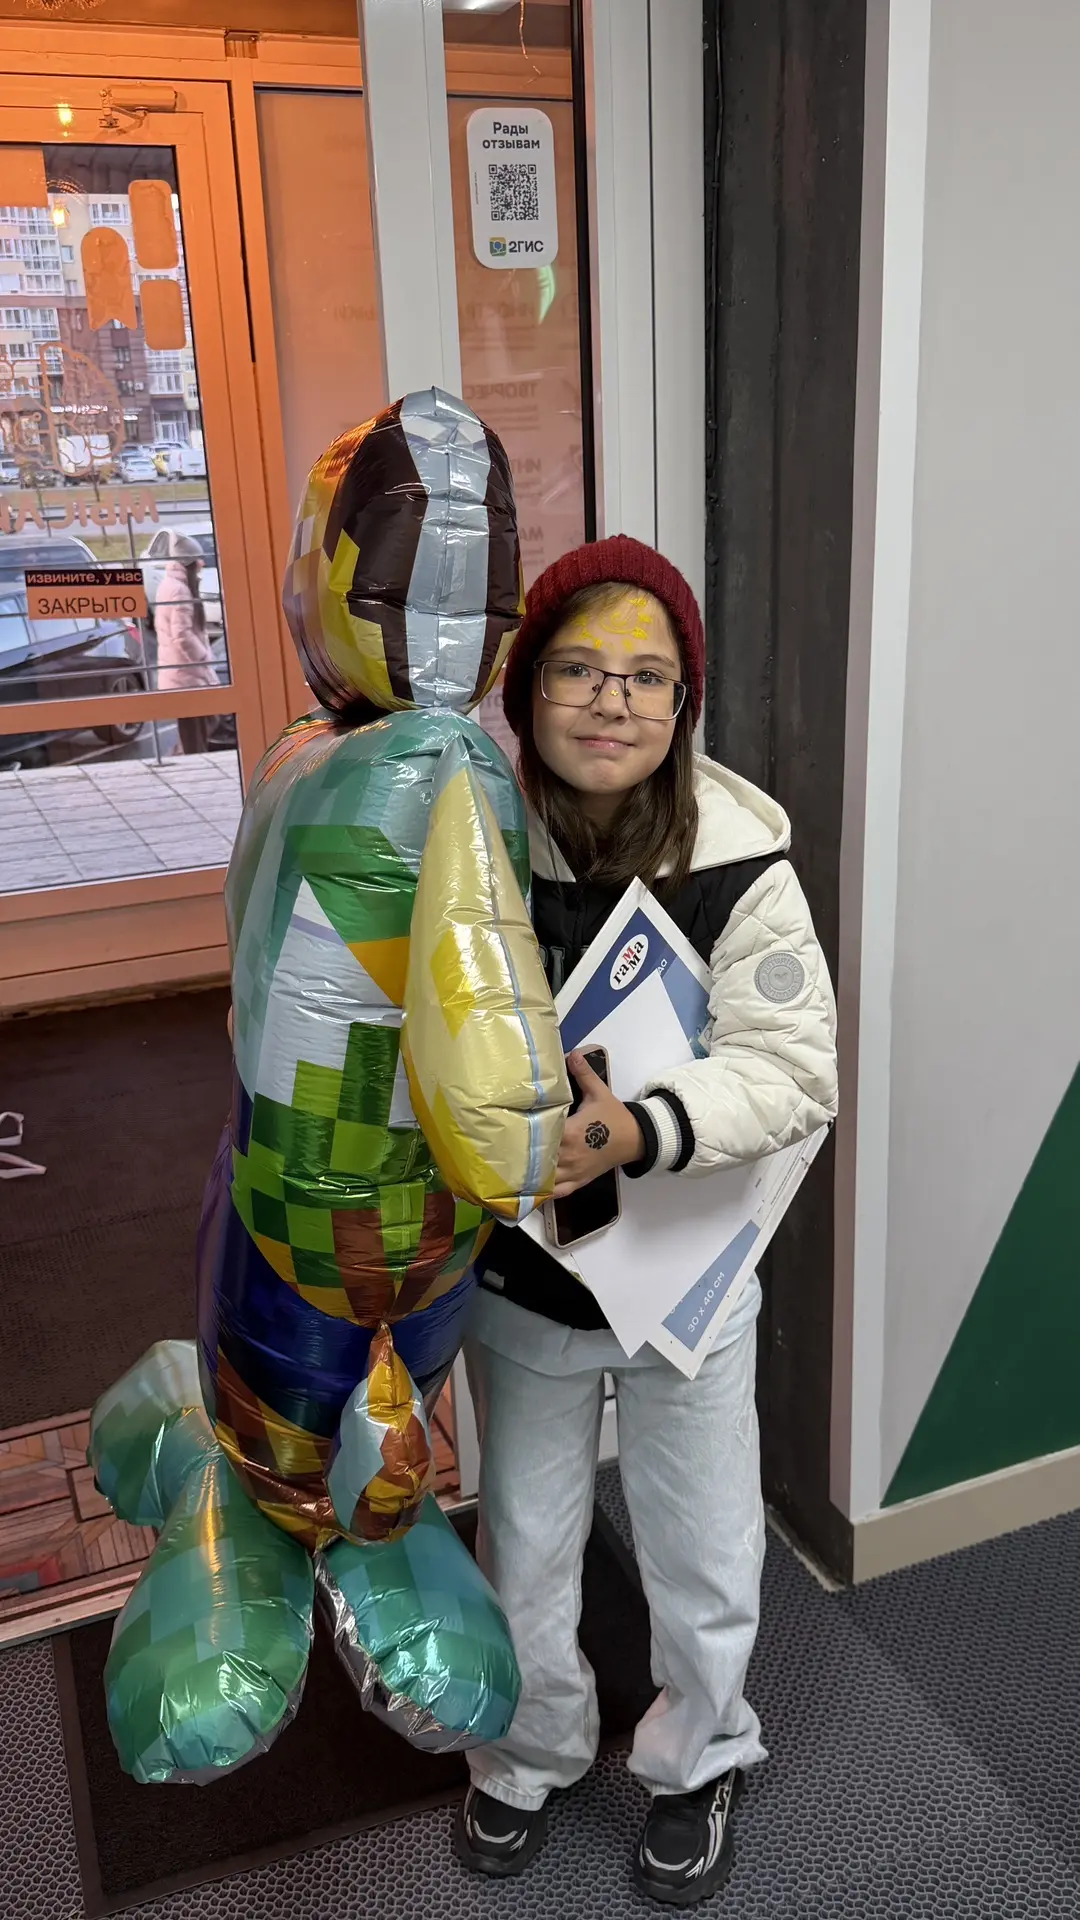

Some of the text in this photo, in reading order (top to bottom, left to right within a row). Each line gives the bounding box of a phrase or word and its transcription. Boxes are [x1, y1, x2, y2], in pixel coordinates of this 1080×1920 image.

[493, 122, 529, 137] Рады
[482, 139, 541, 149] отзывам
[508, 240, 544, 253] 2ГИС
[27, 571, 142, 585] извините, у нас
[38, 596, 137, 615] ЗАКРЫТО
[687, 1316, 699, 1333] 30
[704, 1289, 715, 1306] 40
